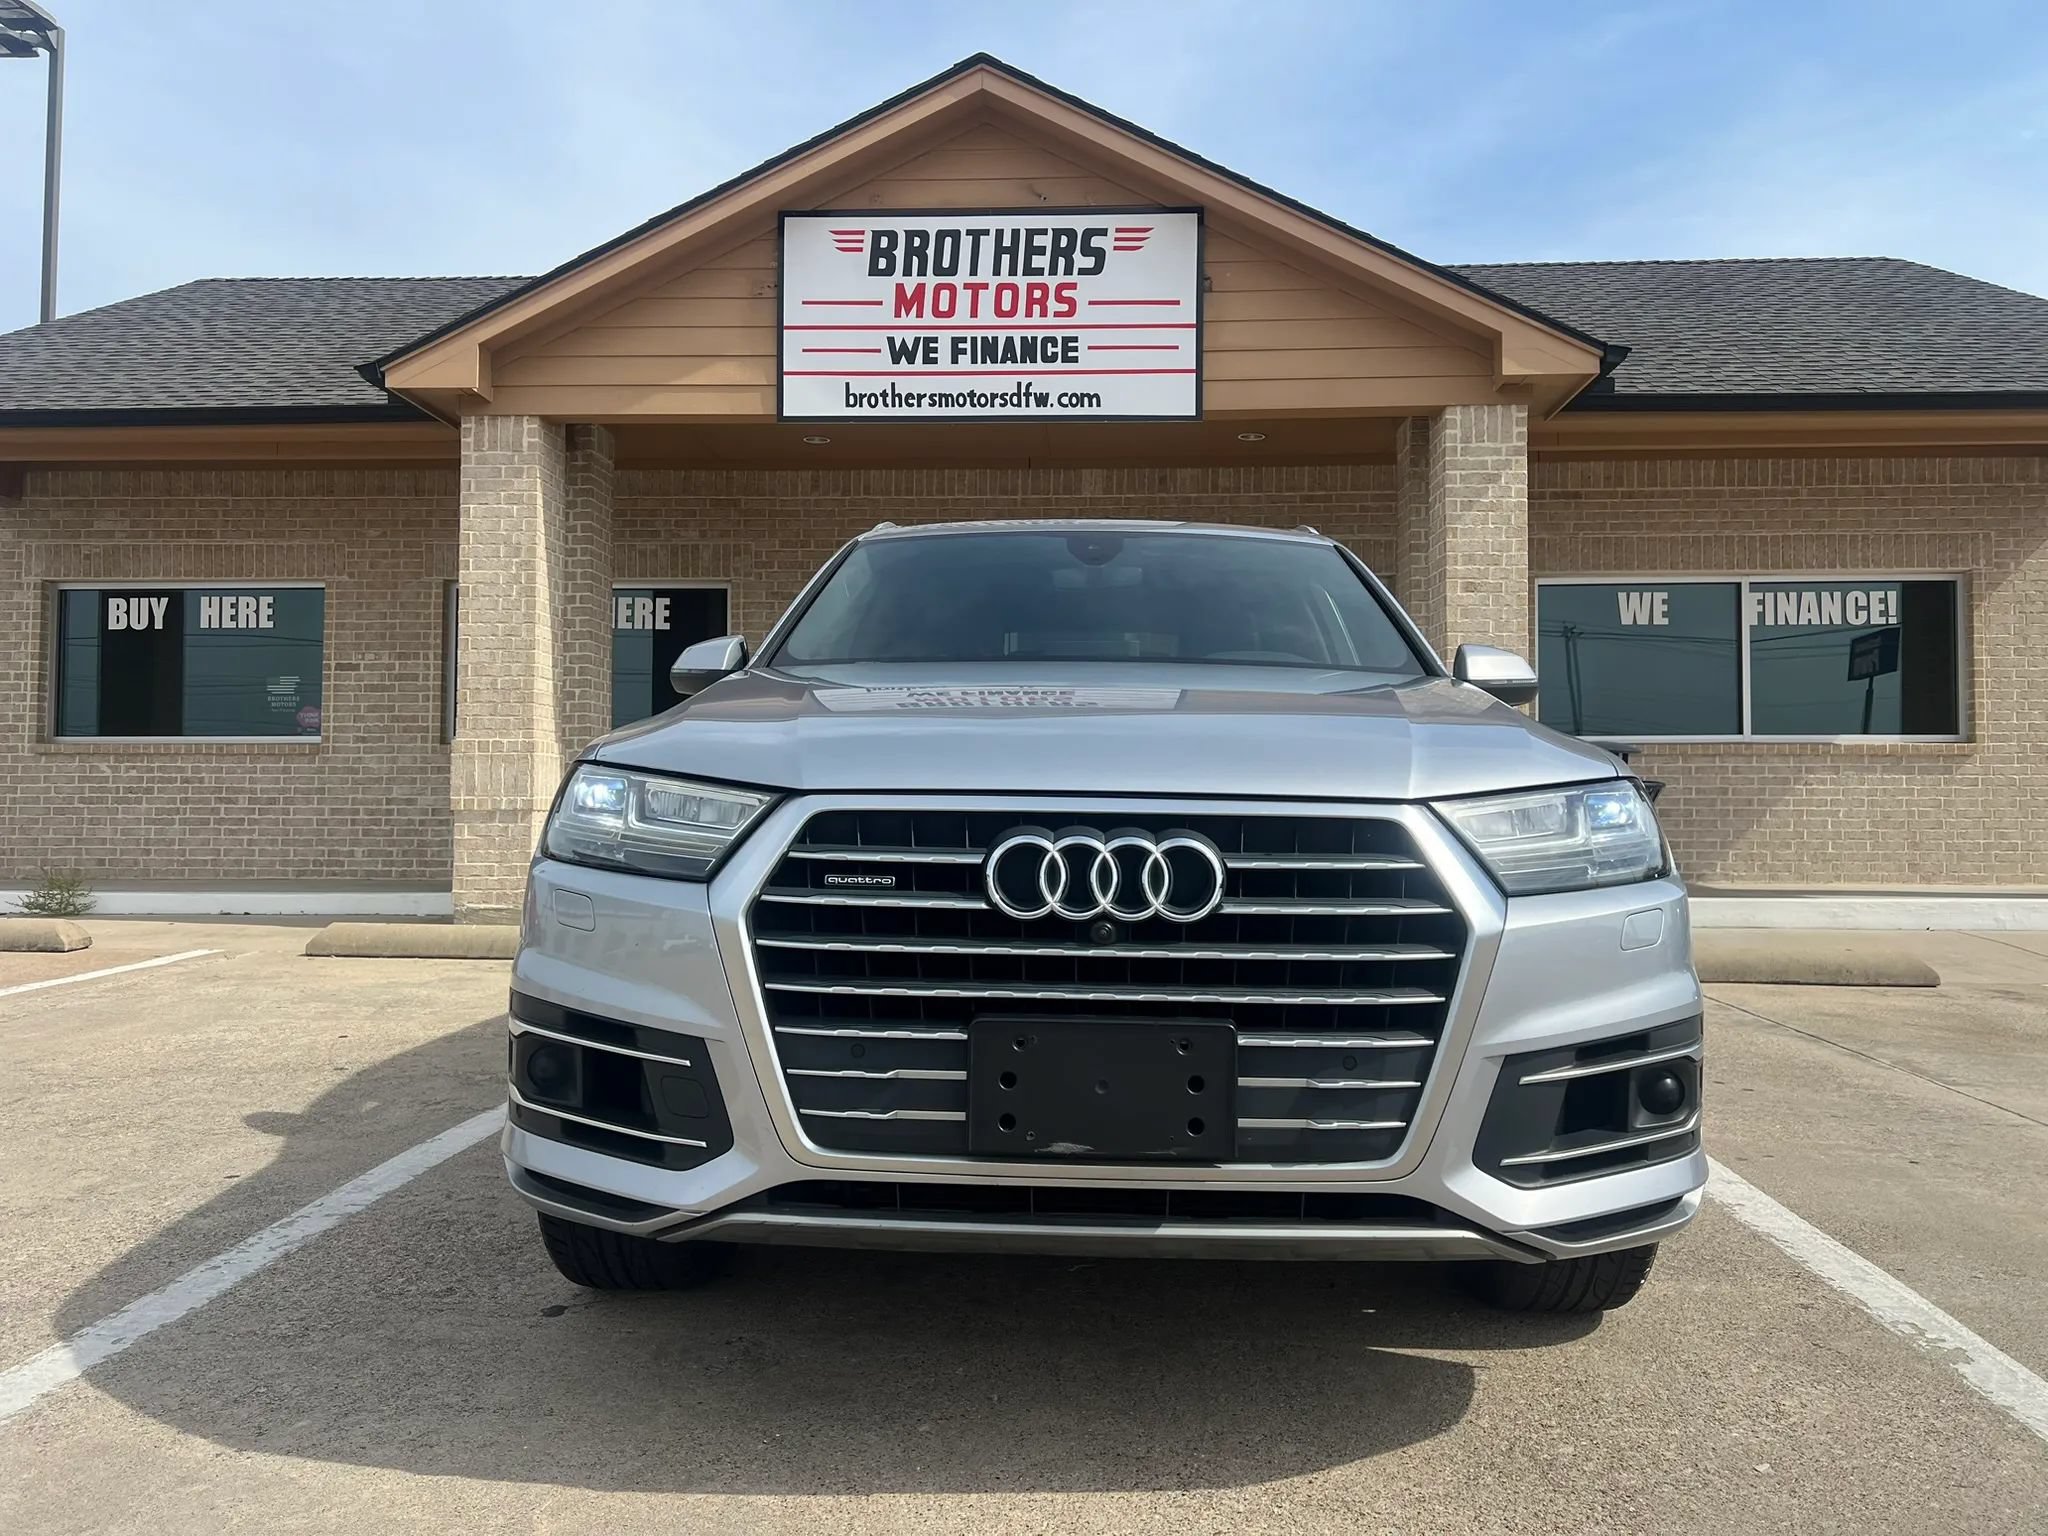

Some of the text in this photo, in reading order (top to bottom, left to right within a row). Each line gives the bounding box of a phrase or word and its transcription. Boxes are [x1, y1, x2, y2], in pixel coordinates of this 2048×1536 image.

[867, 227, 1109, 278] BROTHERS
[893, 282, 1079, 319] MOTORS
[886, 335, 1080, 366] WE FINANCE
[844, 381, 1102, 409] brothersmotorsdfw.com
[107, 596, 275, 631] BUY HERE
[612, 597, 671, 630] ERE
[1617, 590, 1898, 626] WE FINANCE!
